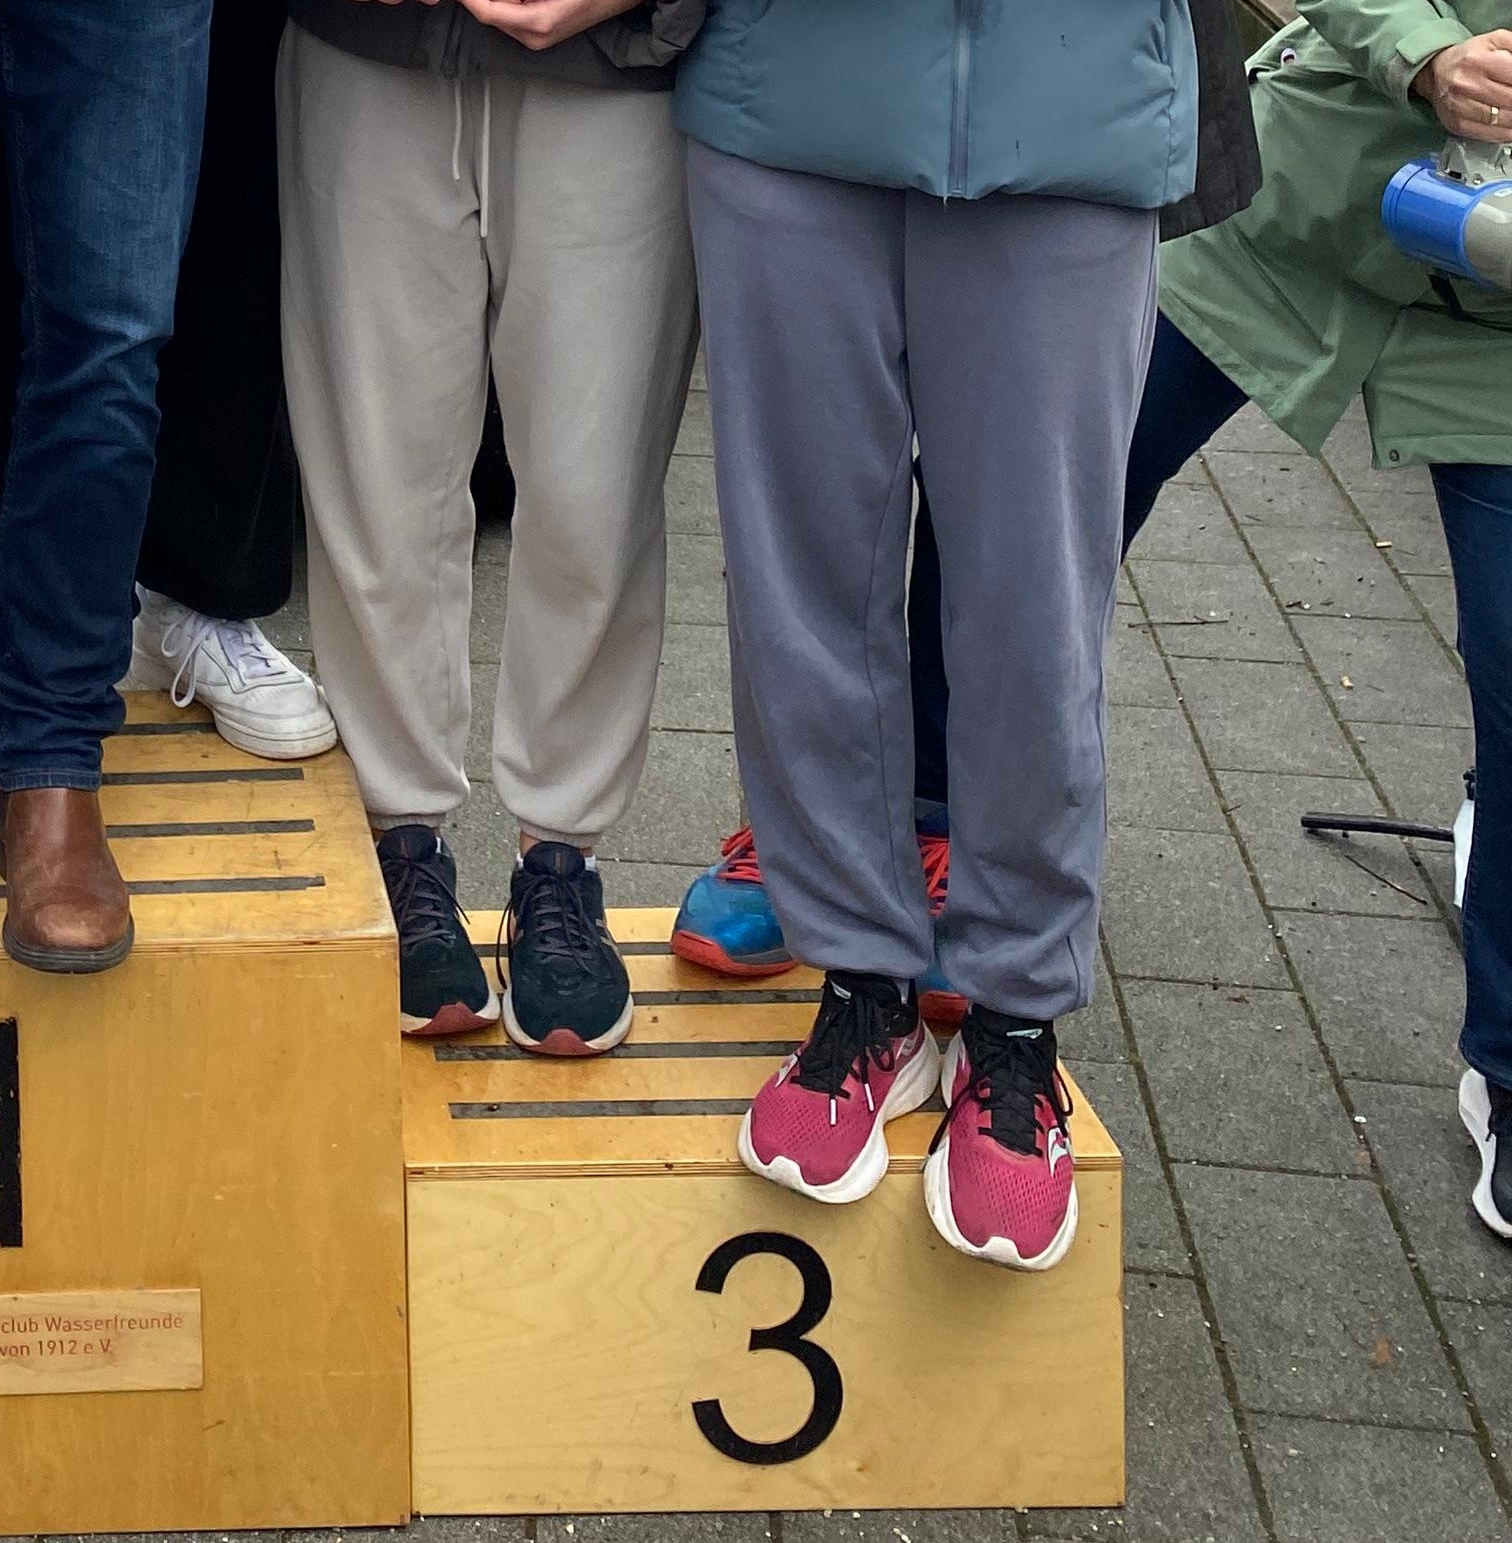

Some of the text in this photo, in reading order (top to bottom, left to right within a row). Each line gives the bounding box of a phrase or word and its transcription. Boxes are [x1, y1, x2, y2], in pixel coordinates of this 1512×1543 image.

[44, 1314, 183, 1332] Wasserfreunde
[0, 1344, 30, 1358] von
[38, 1339, 77, 1356] 1912
[692, 1232, 843, 1465] 3
